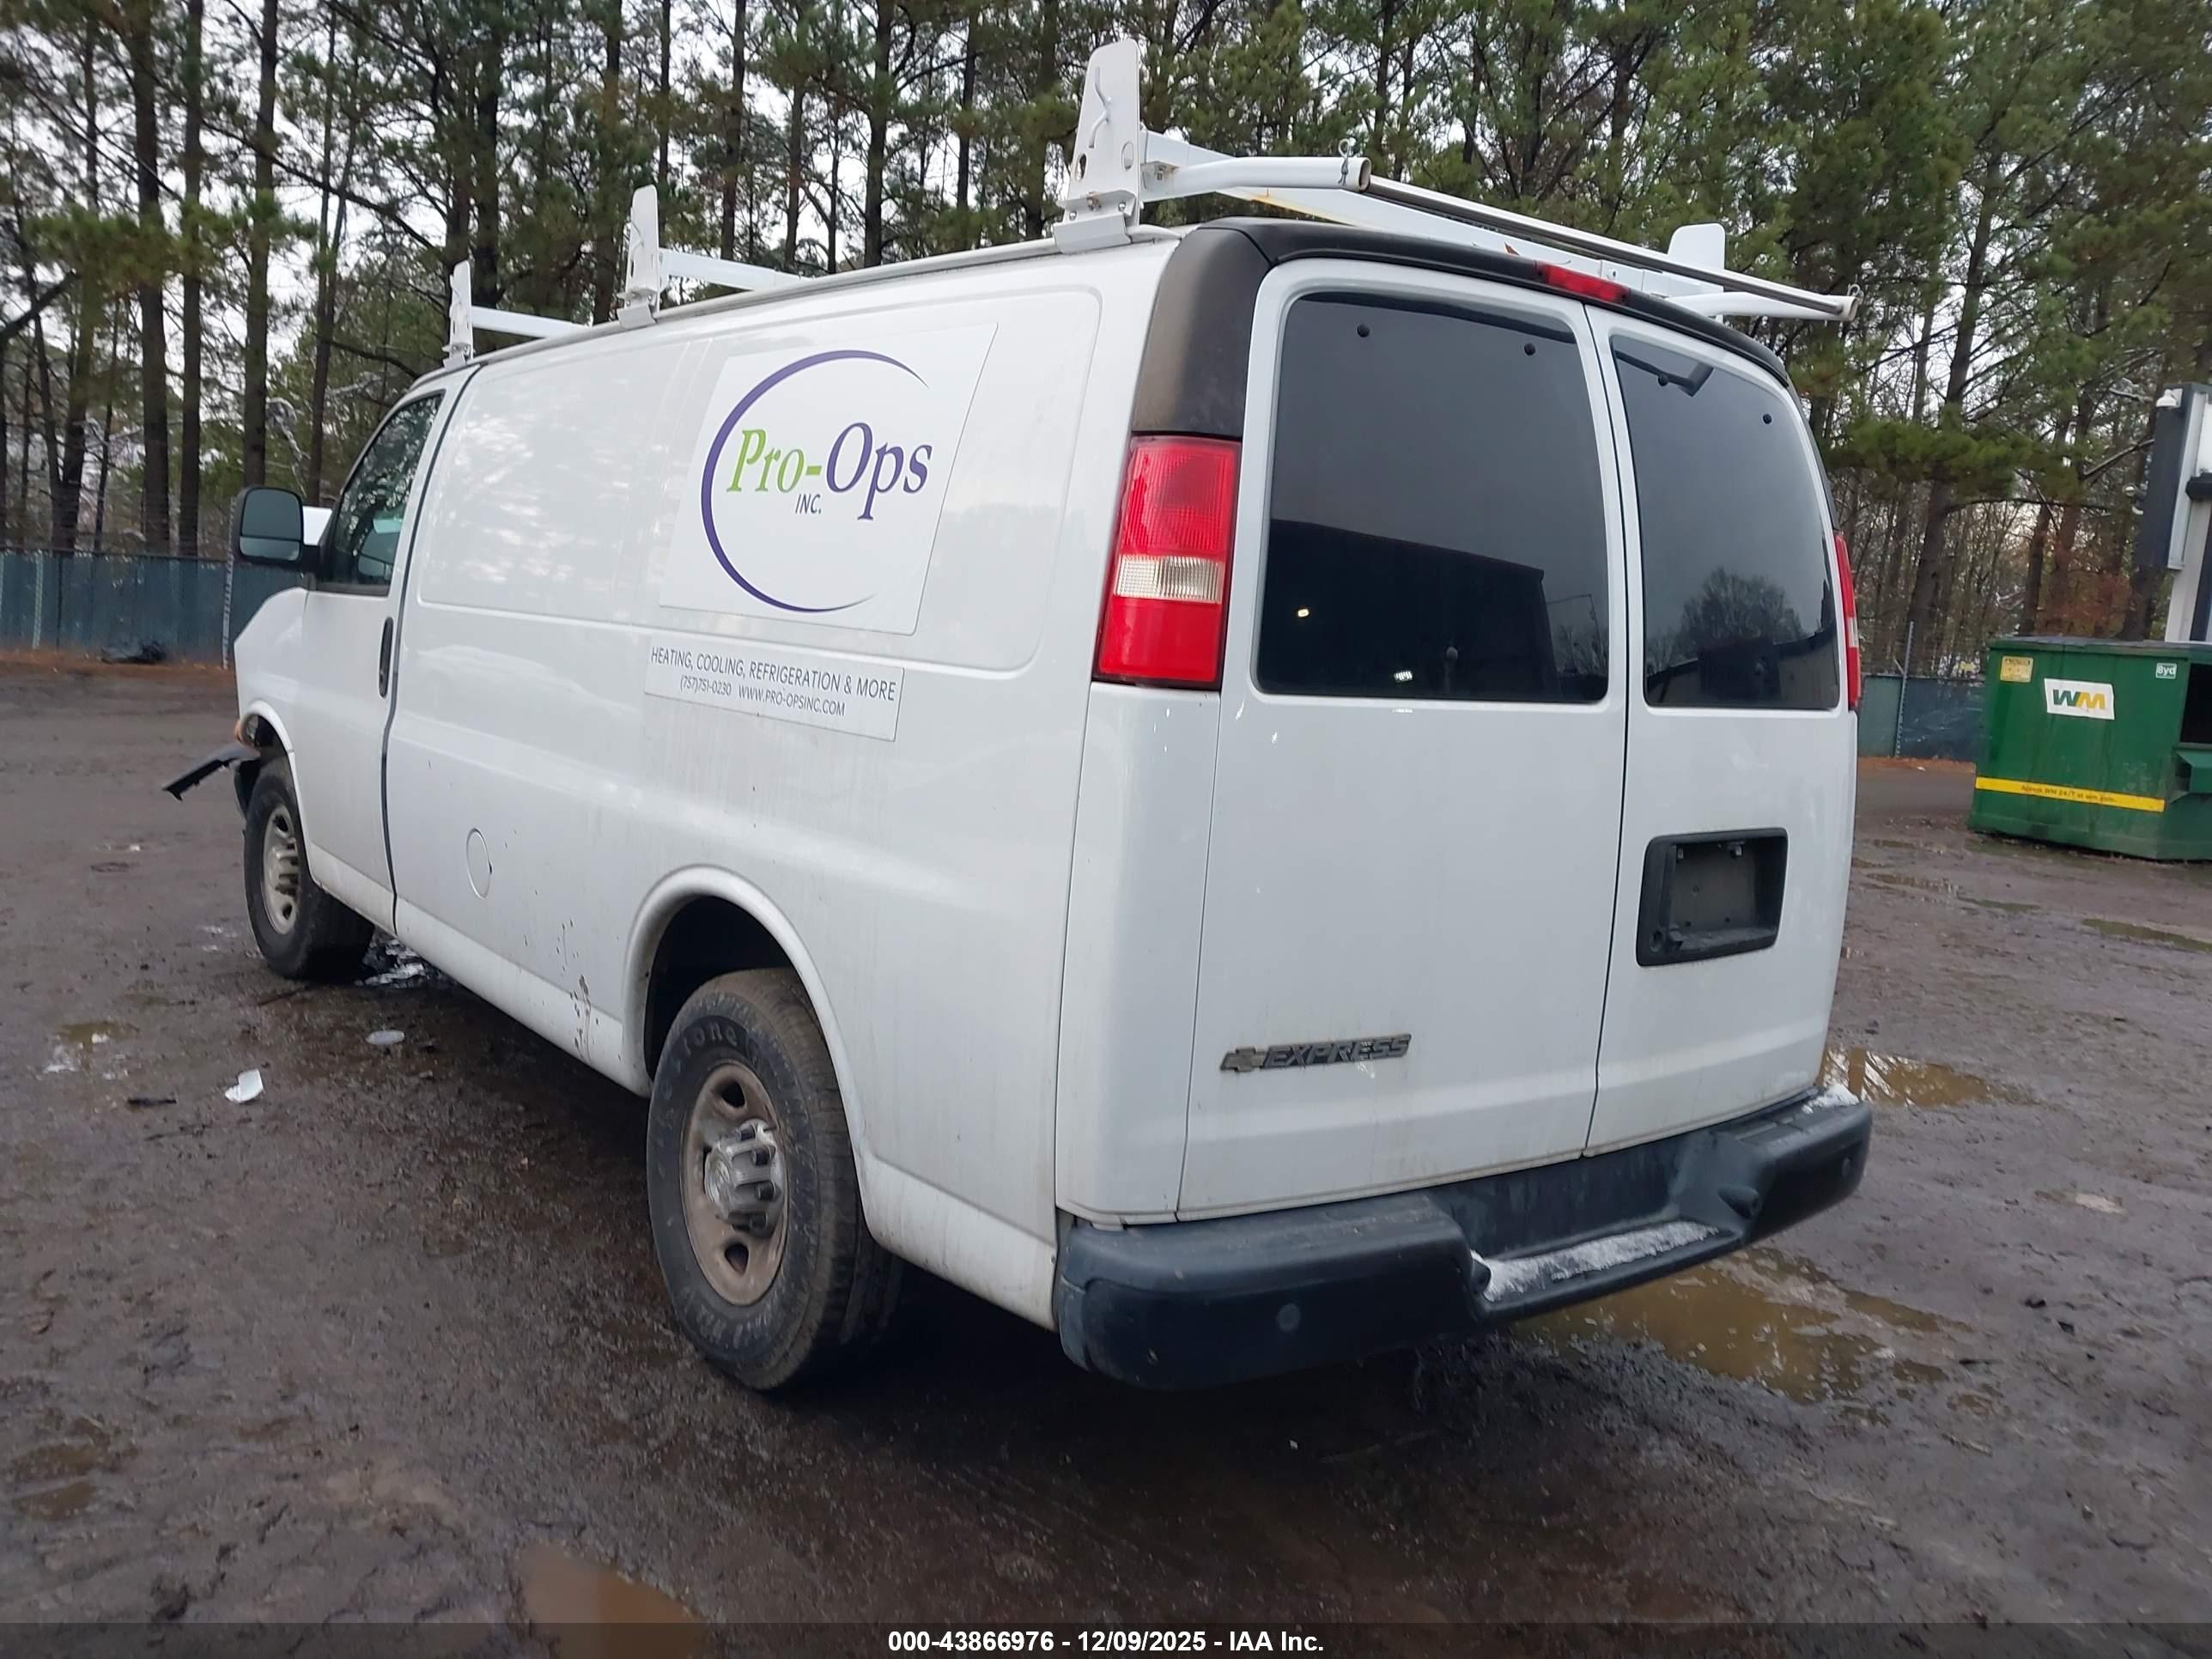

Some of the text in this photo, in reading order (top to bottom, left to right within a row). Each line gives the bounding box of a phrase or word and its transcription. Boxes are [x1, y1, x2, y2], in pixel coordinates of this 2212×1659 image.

[726, 422, 933, 520] Pro-Ops
[795, 494, 822, 514] INC.
[651, 646, 896, 701] HEATING, COOLING, REFRIGERATION & MORE
[2157, 665, 2176, 677] 8yd
[738, 686, 845, 716] WWW.PRO-OPSINC.COM
[2053, 690, 2106, 710] WM
[1263, 1033, 1412, 1069] EXPRESS
